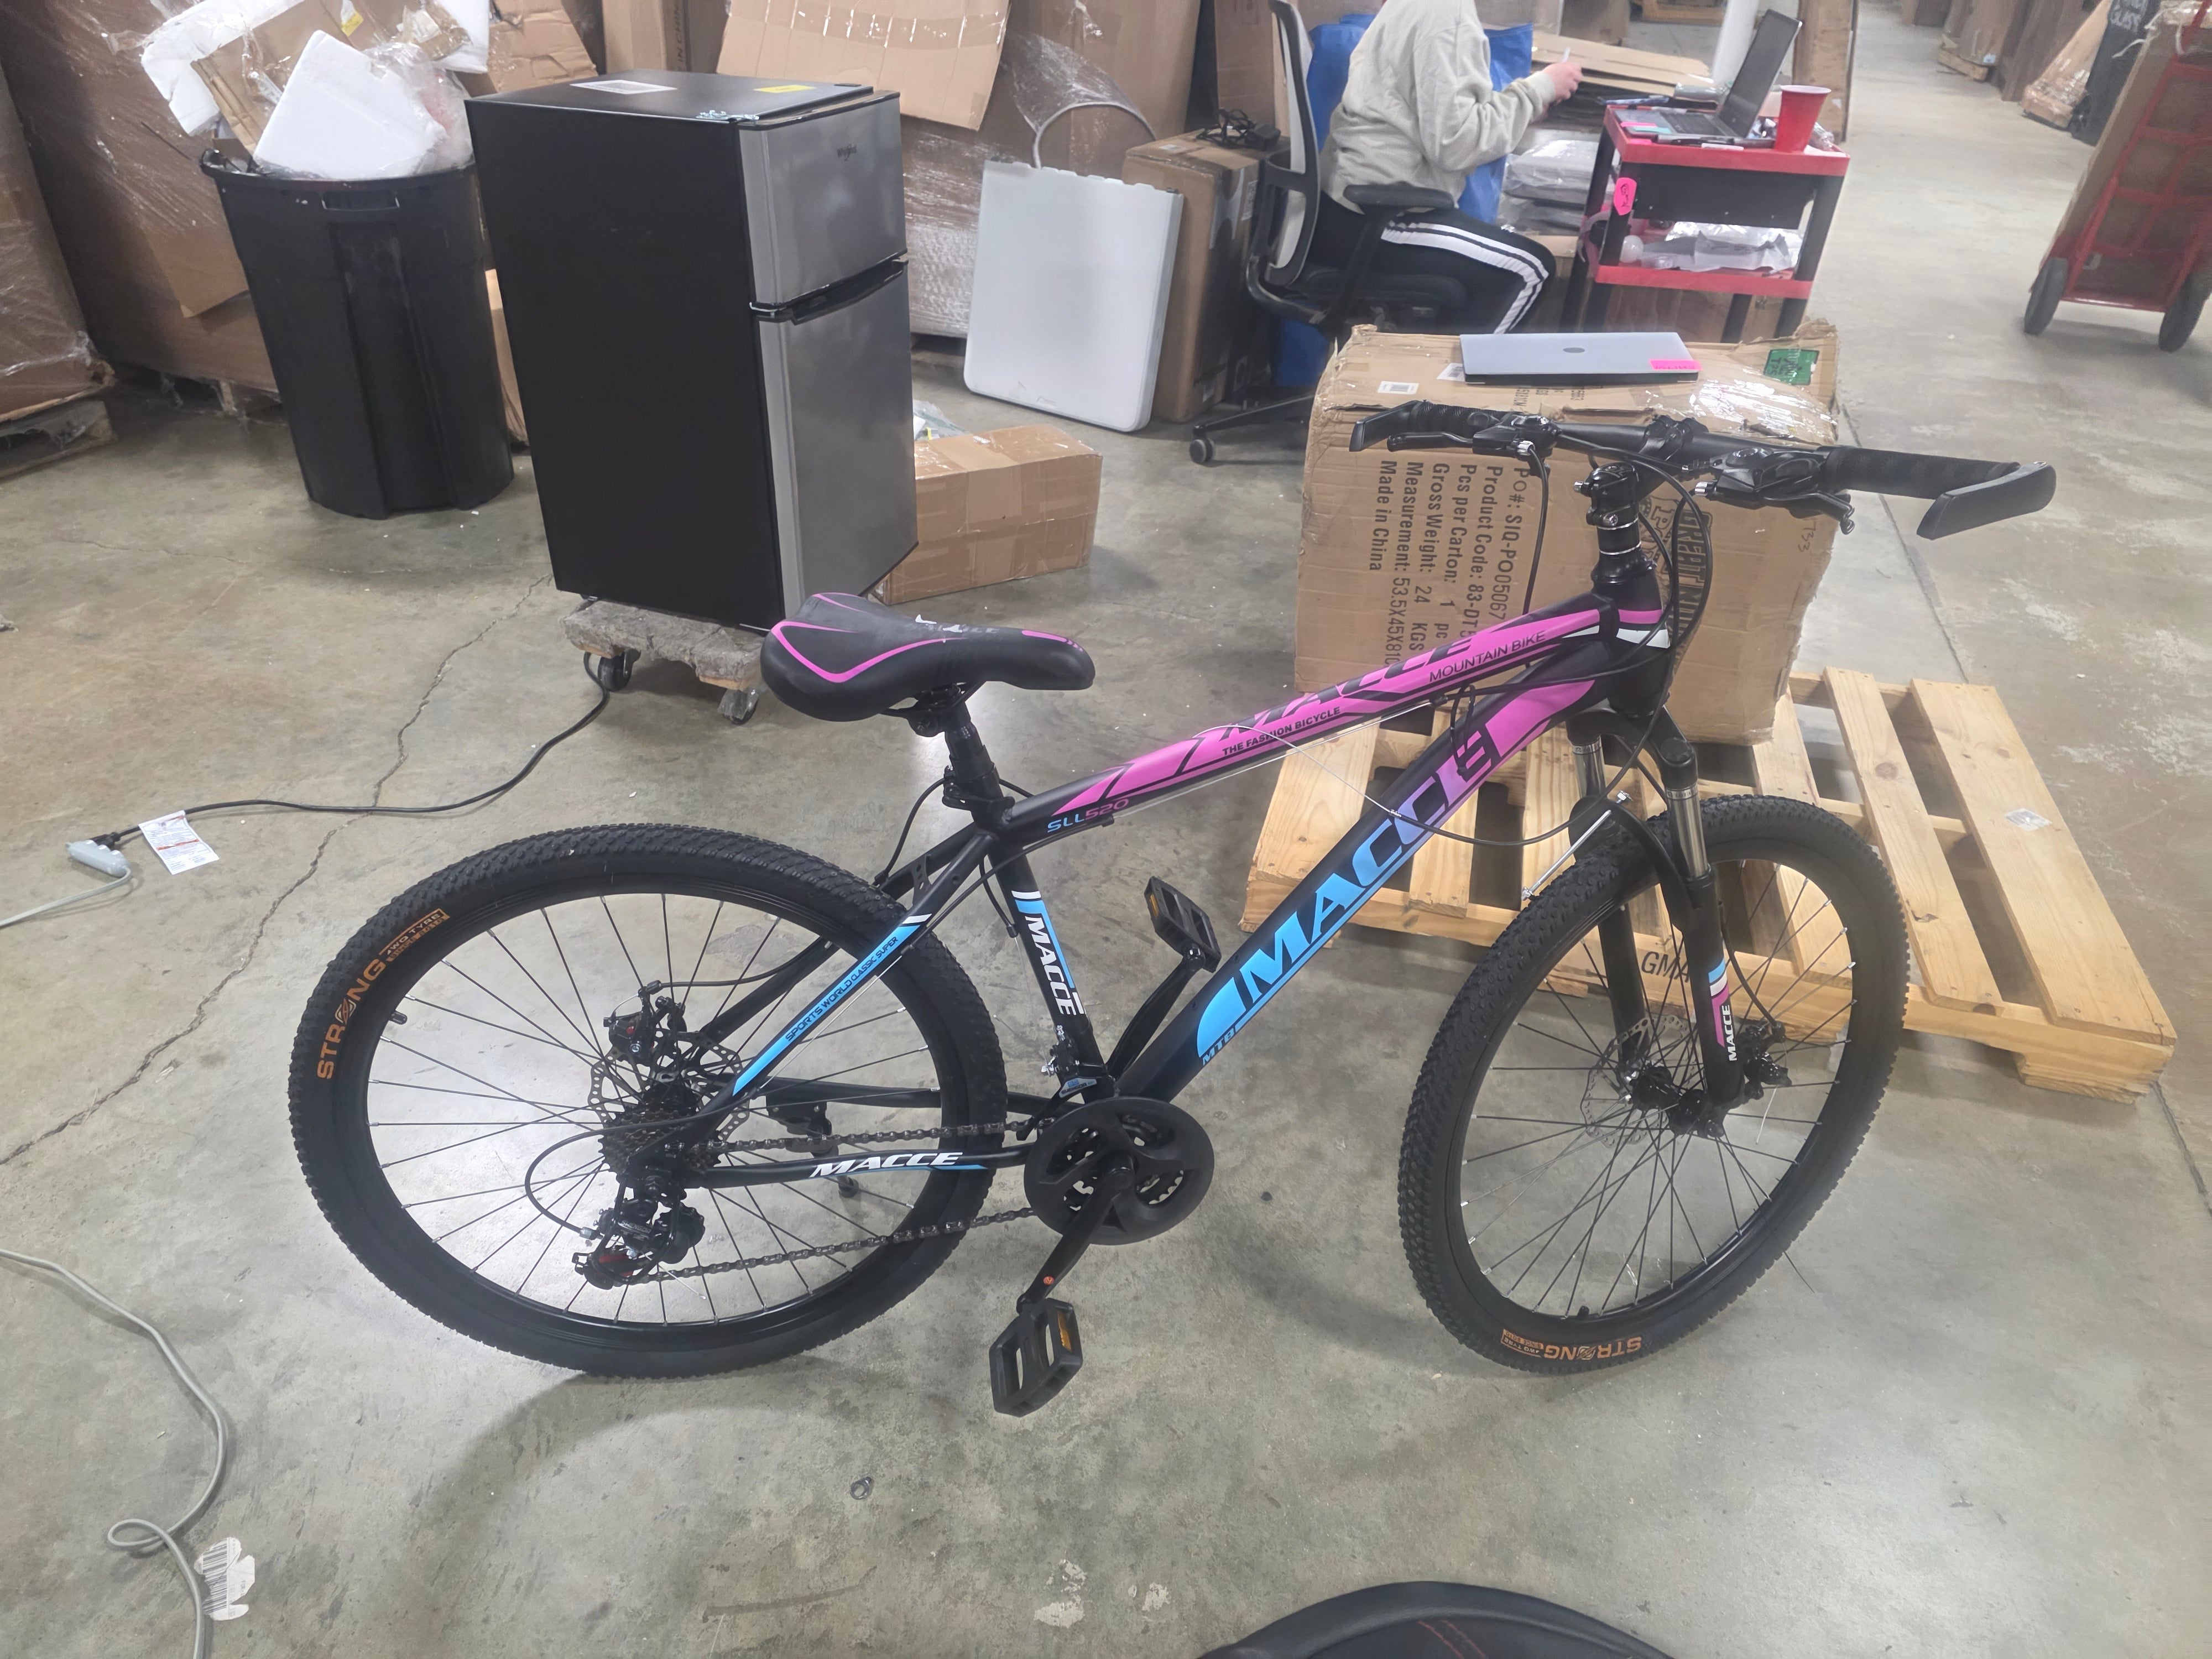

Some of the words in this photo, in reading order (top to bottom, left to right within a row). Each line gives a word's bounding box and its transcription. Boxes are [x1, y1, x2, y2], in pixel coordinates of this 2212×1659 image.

[1377, 461, 1397, 504] Made
[1428, 463, 1450, 510] Gross
[1457, 465, 1478, 492] Pcs
[1478, 466, 1503, 530] Product
[1507, 468, 1530, 508] PO#:
[1375, 509, 1390, 523] in
[1395, 462, 1423, 572] Measurement:
[1452, 497, 1468, 525] per
[1370, 528, 1389, 571] China
[1420, 514, 1443, 572] Weight:
[1444, 528, 1467, 583] Carton:
[1470, 534, 1492, 578] Code:
[1489, 515, 1522, 620] SIQ-PO05067
[1415, 586, 1432, 603] 24
[1409, 623, 1428, 651] KGS
[1434, 623, 1449, 639] pc
[1430, 645, 1508, 682] MOUNTAIN
[1511, 630, 1546, 653] BIKE
[1223, 744, 1244, 756] THE
[1245, 725, 1292, 750] FASHION
[1295, 706, 1341, 731] BICYCLE
[1239, 731, 1491, 1004] MACCE
[785, 1006, 823, 1041] SPORTS
[821, 980, 852, 1008] WORLD
[852, 956, 878, 981] CLASSIC
[876, 937, 899, 958] SUPER
[1025, 916, 1076, 1015] MACCE
[1721, 1005, 1737, 1061] MACCE
[810, 1152, 962, 1177] MACCE
